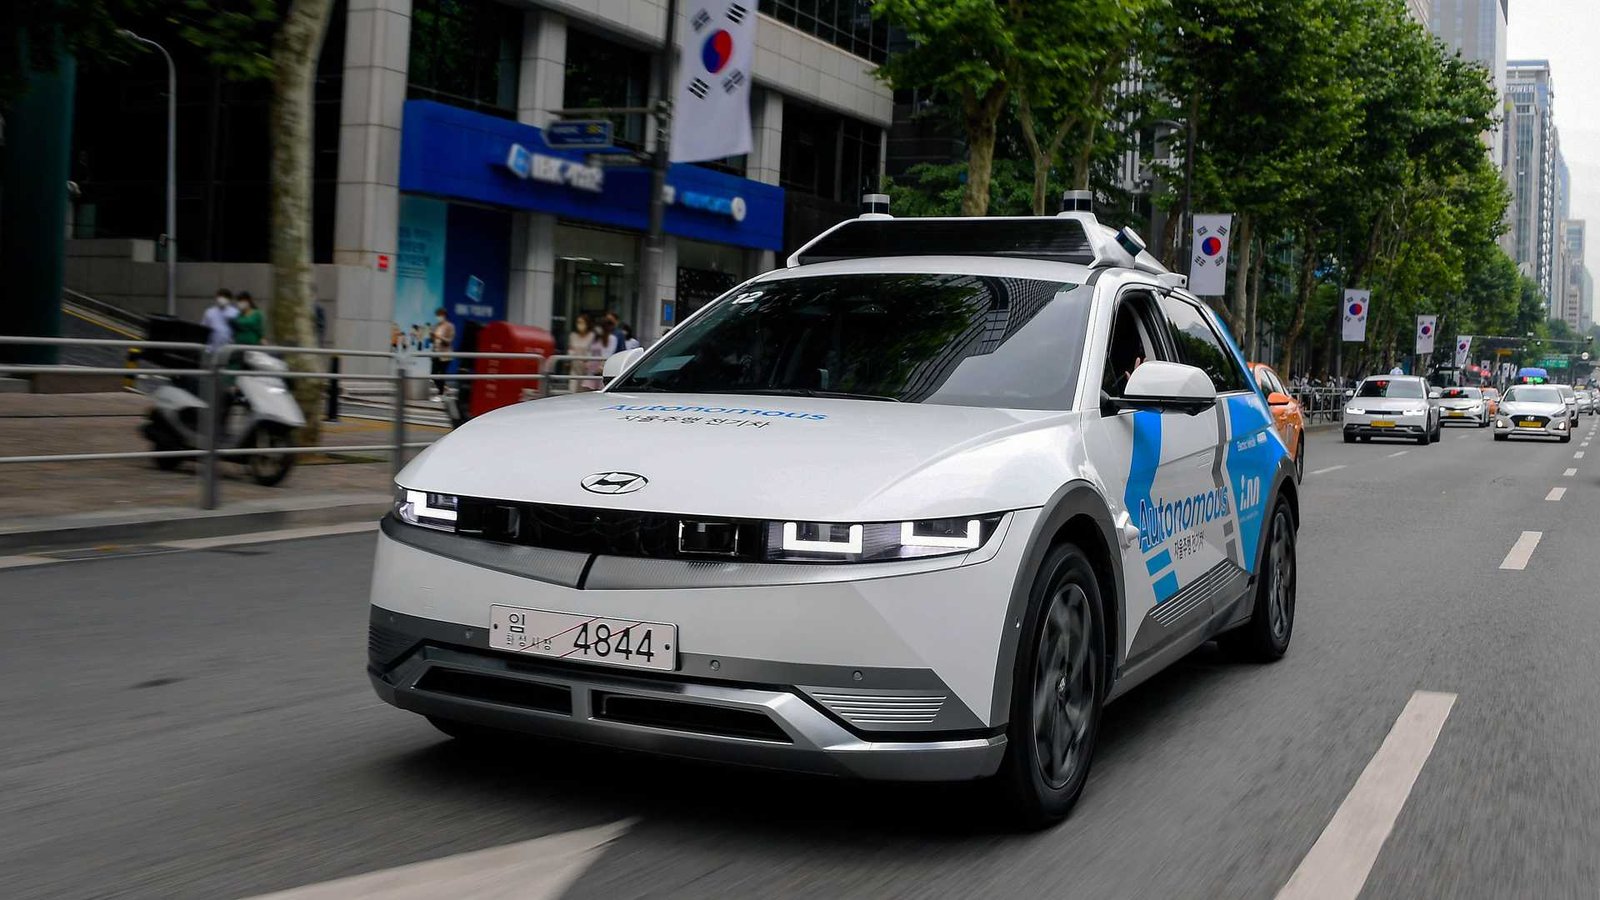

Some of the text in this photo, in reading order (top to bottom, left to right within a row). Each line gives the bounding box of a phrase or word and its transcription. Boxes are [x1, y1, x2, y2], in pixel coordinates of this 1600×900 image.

[731, 291, 764, 304] 12
[599, 405, 828, 420] Autonomous
[616, 415, 703, 425] 자율주행
[1139, 486, 1228, 549] Autonomous
[509, 613, 525, 633] 임
[573, 622, 655, 663] 4844
